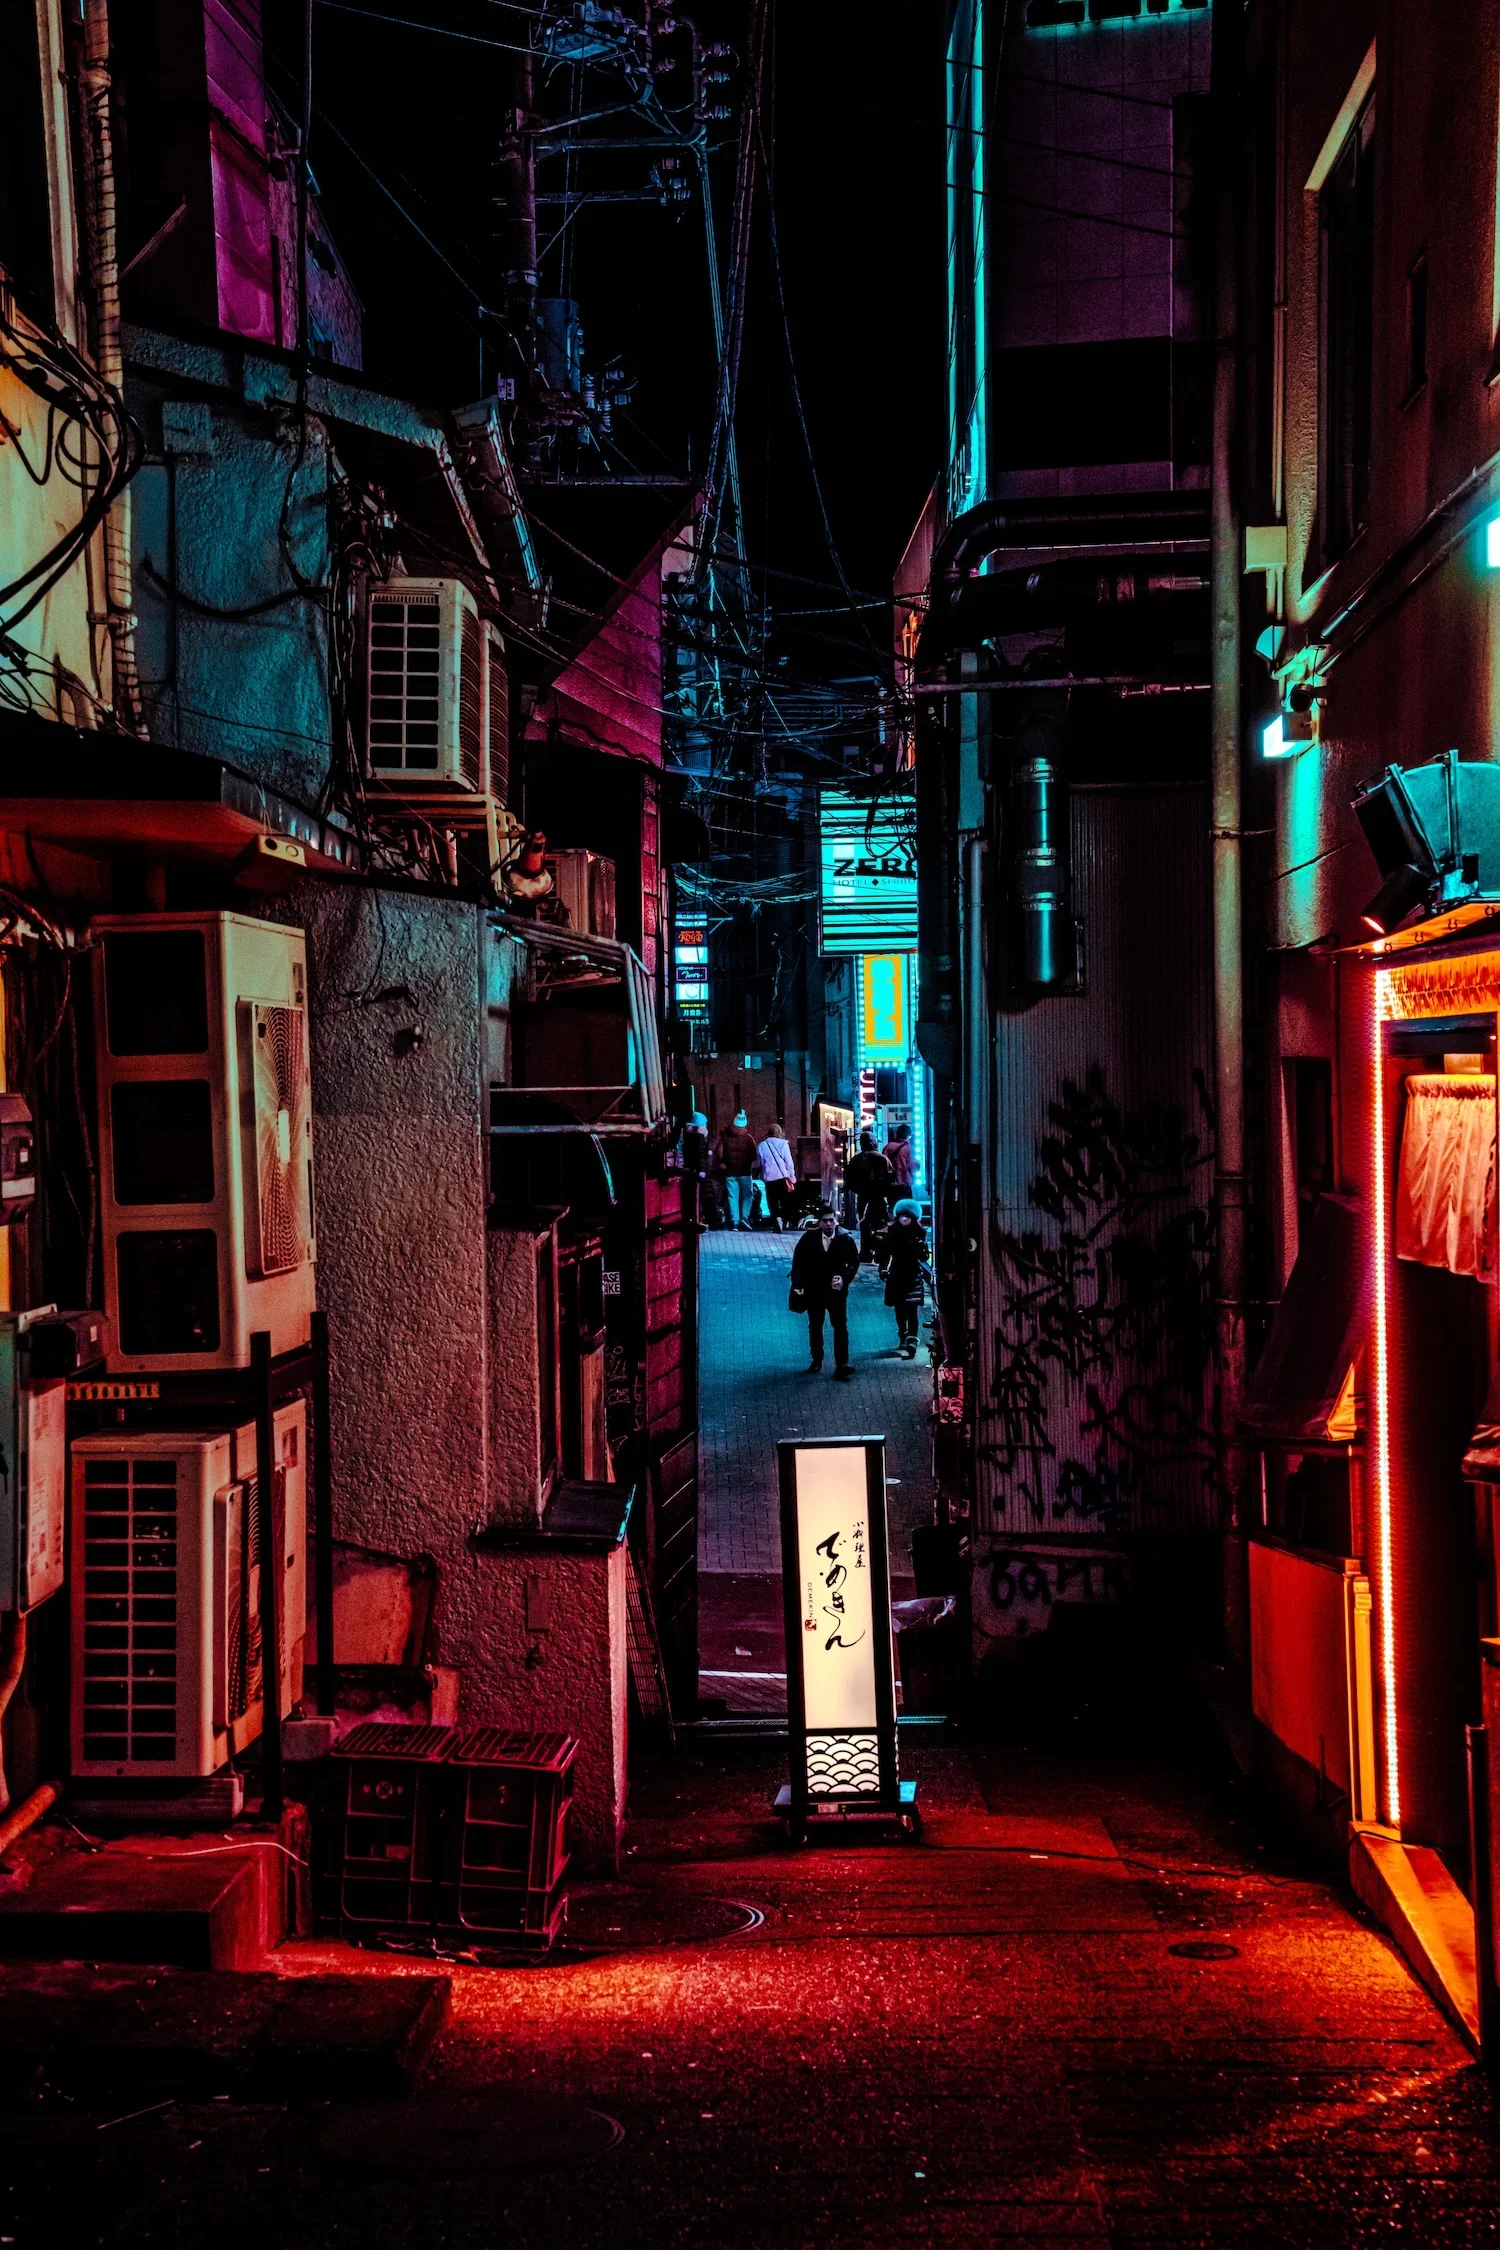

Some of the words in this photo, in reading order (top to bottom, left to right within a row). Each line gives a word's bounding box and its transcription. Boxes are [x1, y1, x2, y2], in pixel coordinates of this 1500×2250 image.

[853, 1521, 866, 1569] 小料理屋
[816, 1531, 866, 1651] でめきん
